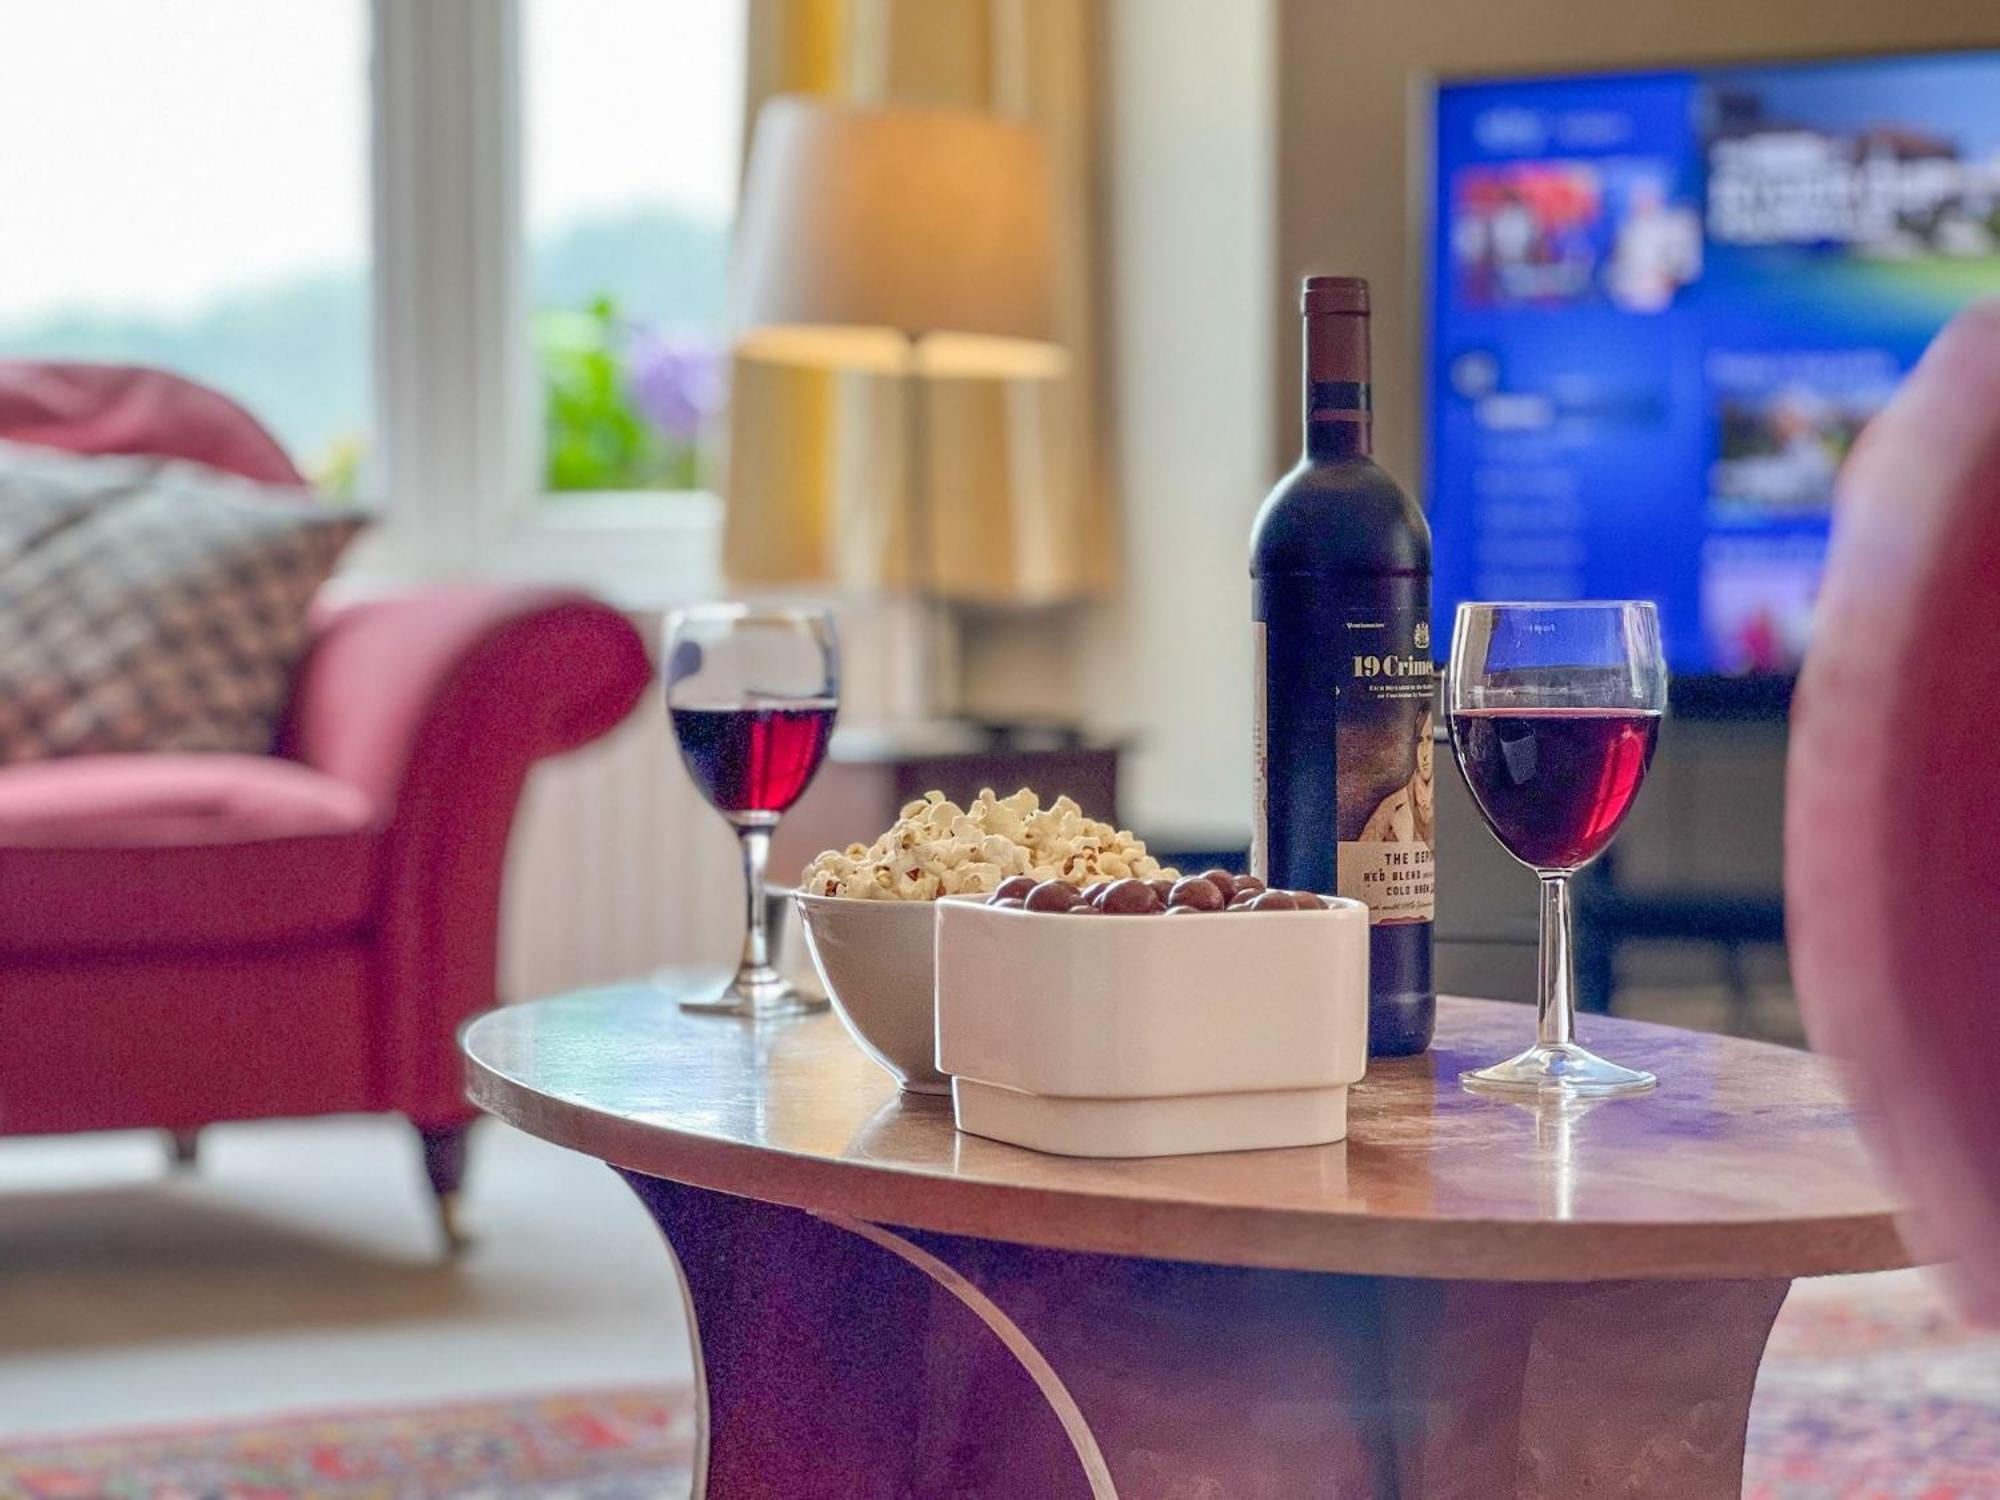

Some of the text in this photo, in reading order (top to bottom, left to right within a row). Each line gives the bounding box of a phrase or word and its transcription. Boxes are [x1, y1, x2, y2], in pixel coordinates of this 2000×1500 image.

[1353, 656, 1380, 677] 19
[1385, 852, 1409, 865] THE
[1364, 871, 1385, 882] RED
[1392, 870, 1421, 881] BLEND
[1386, 885, 1410, 896] COLD
